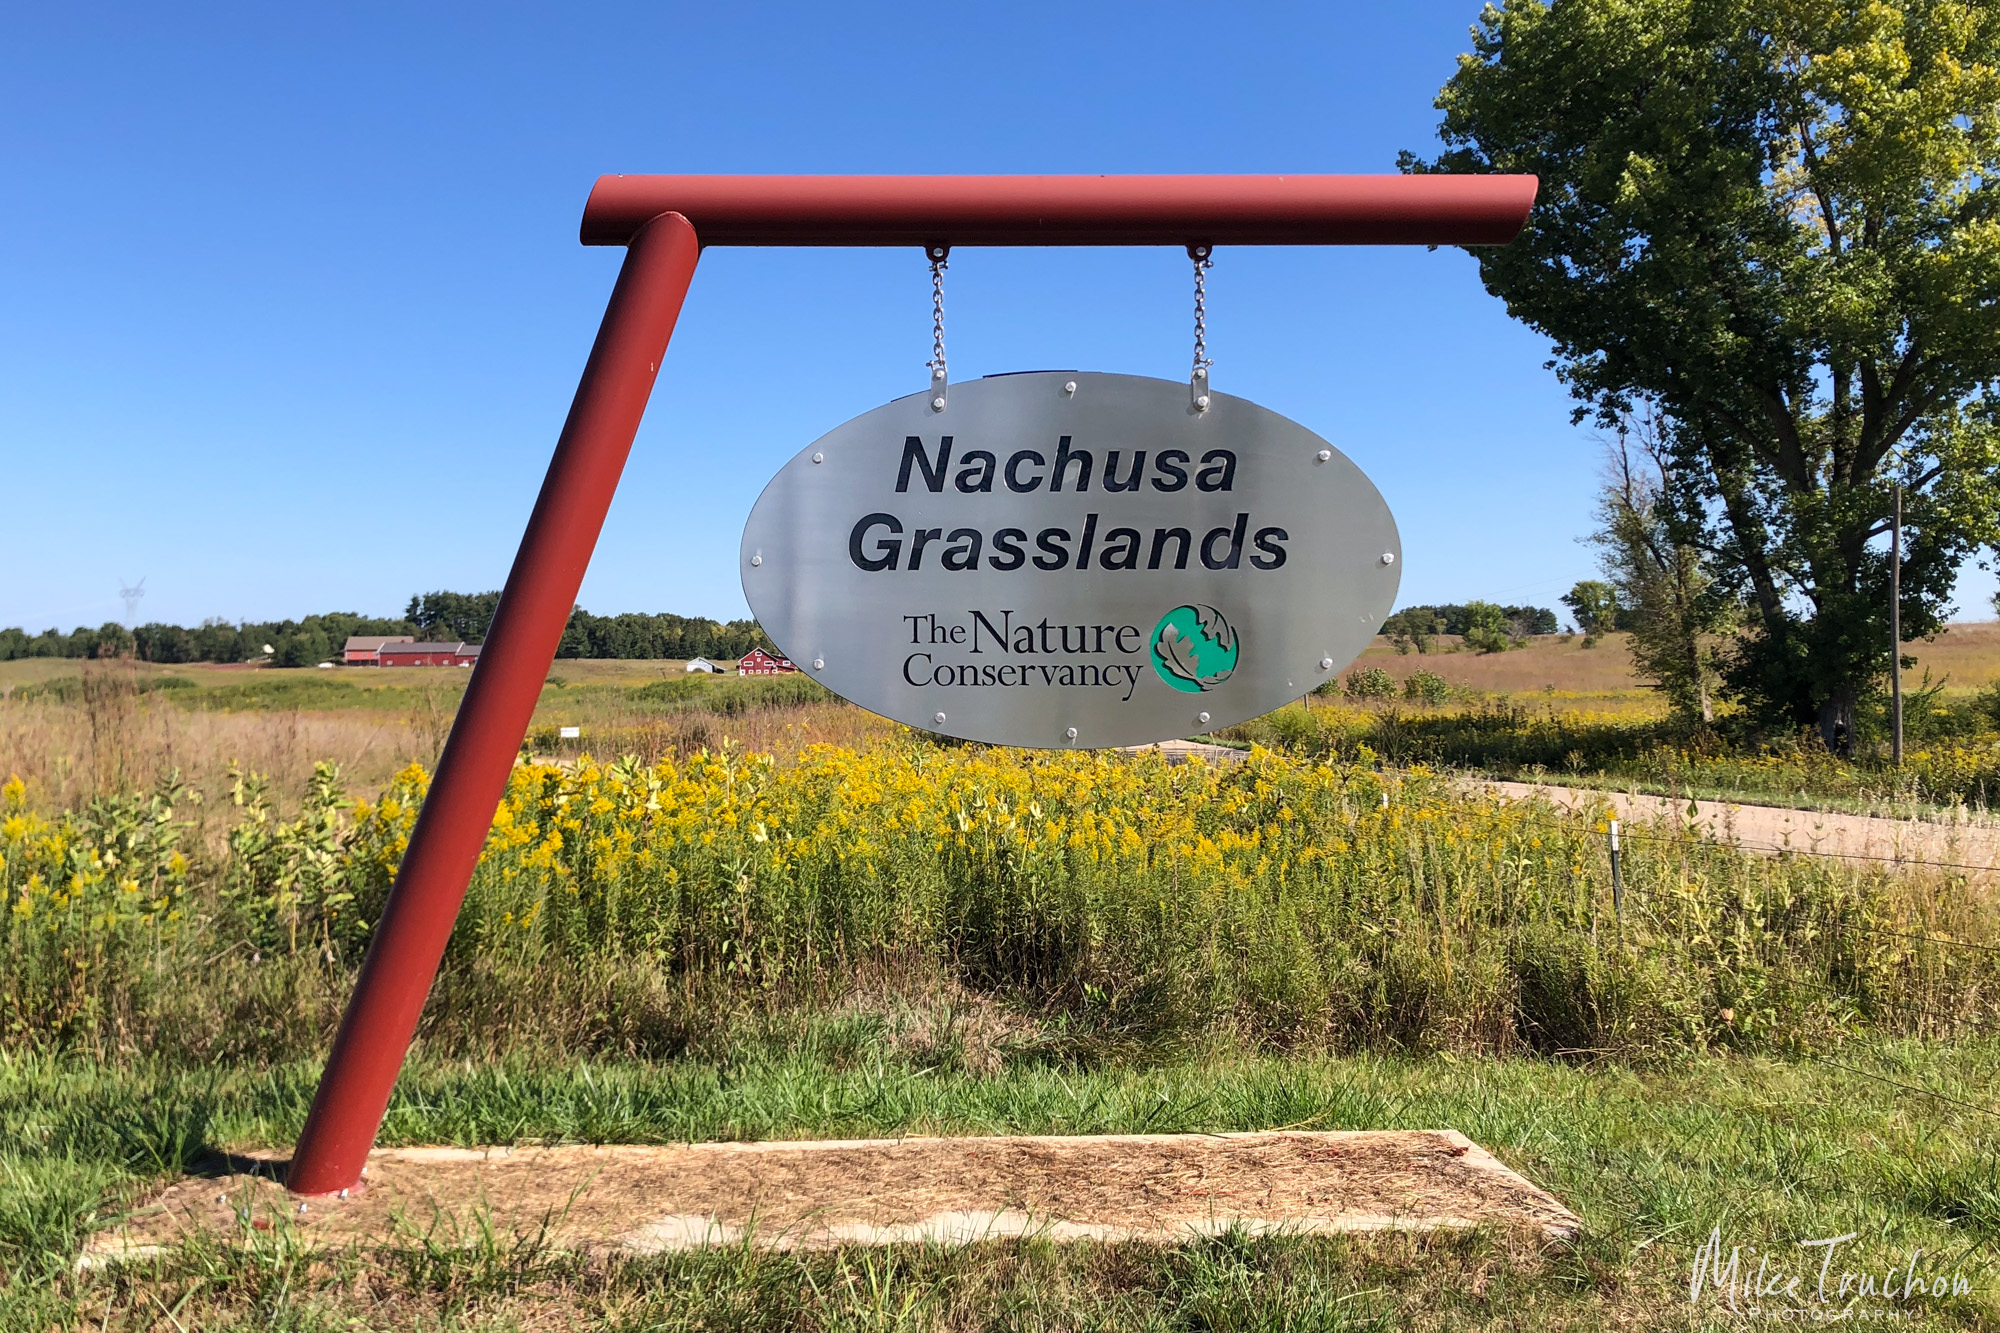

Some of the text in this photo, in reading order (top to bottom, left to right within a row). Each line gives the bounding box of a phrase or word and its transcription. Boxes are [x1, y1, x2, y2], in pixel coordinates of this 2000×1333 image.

[894, 435, 1238, 494] Nachusa
[848, 512, 1289, 572] Grasslands
[903, 610, 1142, 654] The Nature
[902, 652, 1144, 702] Conservancy
